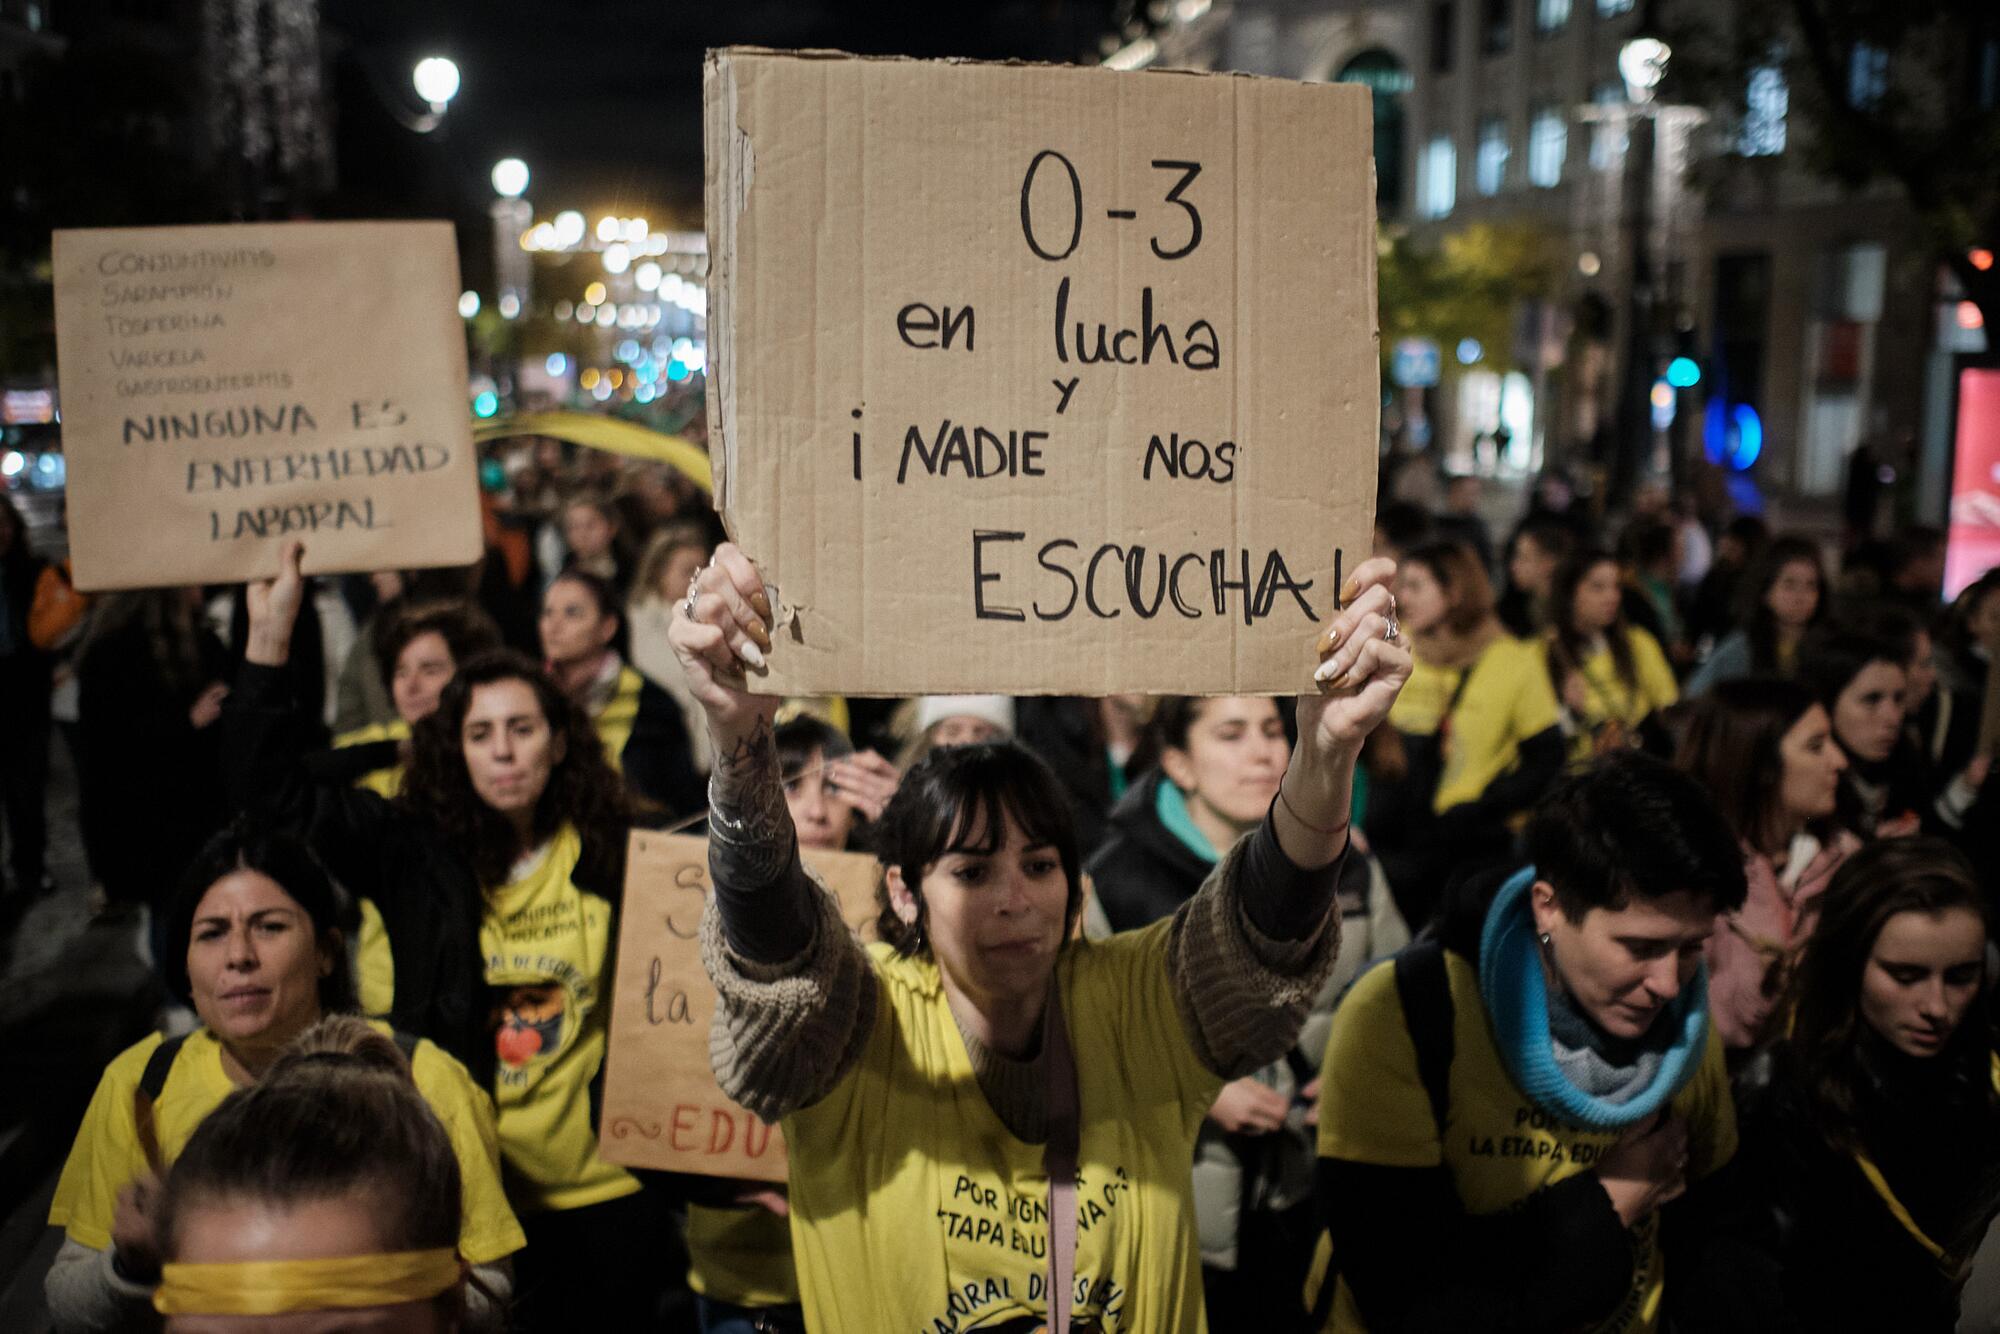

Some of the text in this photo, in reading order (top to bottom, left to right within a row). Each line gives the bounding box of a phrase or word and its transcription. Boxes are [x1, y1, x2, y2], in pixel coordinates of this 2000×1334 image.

[1020, 149, 1203, 261] 0-3
[896, 276, 1220, 370] en lucha
[122, 400, 408, 445] NINGUNA ES
[185, 442, 451, 493] ENFERMEDAD
[1143, 433, 1238, 484] NOS
[209, 497, 396, 542] LABORAL
[645, 955, 696, 1026] la
[669, 1103, 777, 1160] EDU
[1468, 1136, 1495, 1157] LA
[1501, 1136, 1565, 1163] ETAPA
[954, 1174, 998, 1211] POR
[937, 1208, 1005, 1248] TAPA
